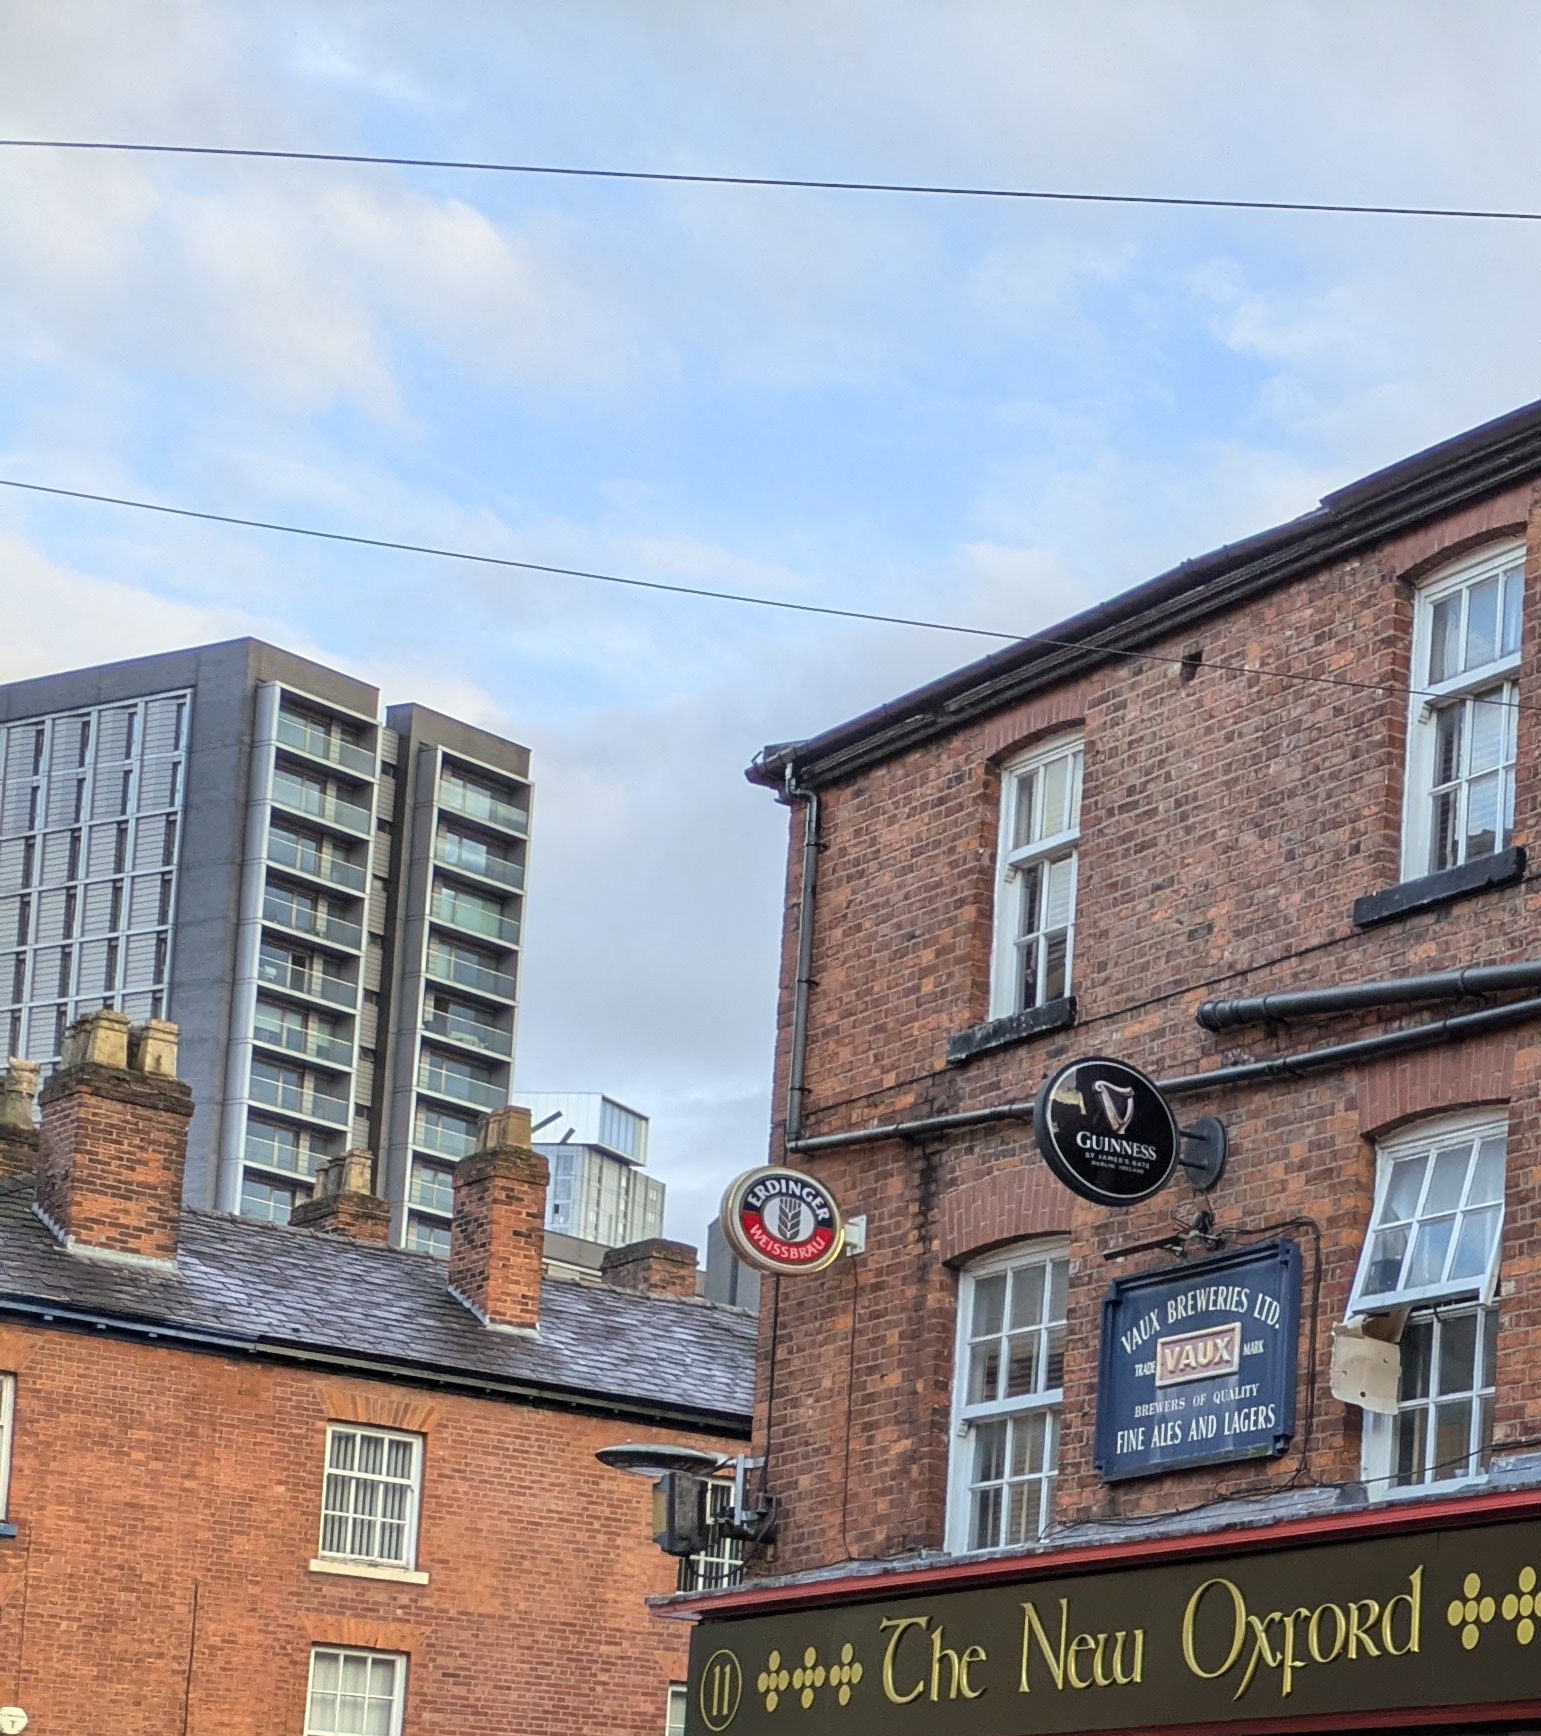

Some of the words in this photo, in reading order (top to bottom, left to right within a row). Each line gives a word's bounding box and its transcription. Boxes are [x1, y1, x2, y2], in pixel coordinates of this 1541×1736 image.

[1076, 1131, 1157, 1160] GUINNESS
[747, 1179, 830, 1221] ERDINGER
[1120, 1308, 1161, 1355] VAUX
[1167, 1285, 1250, 1324] BREWERIES
[1253, 1293, 1281, 1330] LTD.
[1134, 1361, 1157, 1377] TRADE
[1164, 1336, 1232, 1374] VAUX
[1242, 1339, 1265, 1356] MARK
[1134, 1397, 1186, 1418] BREWERS
[1192, 1393, 1207, 1407] OF
[1213, 1383, 1260, 1405] QUALITY
[1116, 1427, 1146, 1454] FINE
[1151, 1420, 1183, 1448] ALES
[1188, 1414, 1217, 1442] AND
[1223, 1403, 1276, 1435] LAGERS
[879, 1615, 988, 1704] The
[1018, 1597, 1146, 1693] New
[1181, 1564, 1425, 1702] Oxford
[712, 1663, 731, 1716] 11
